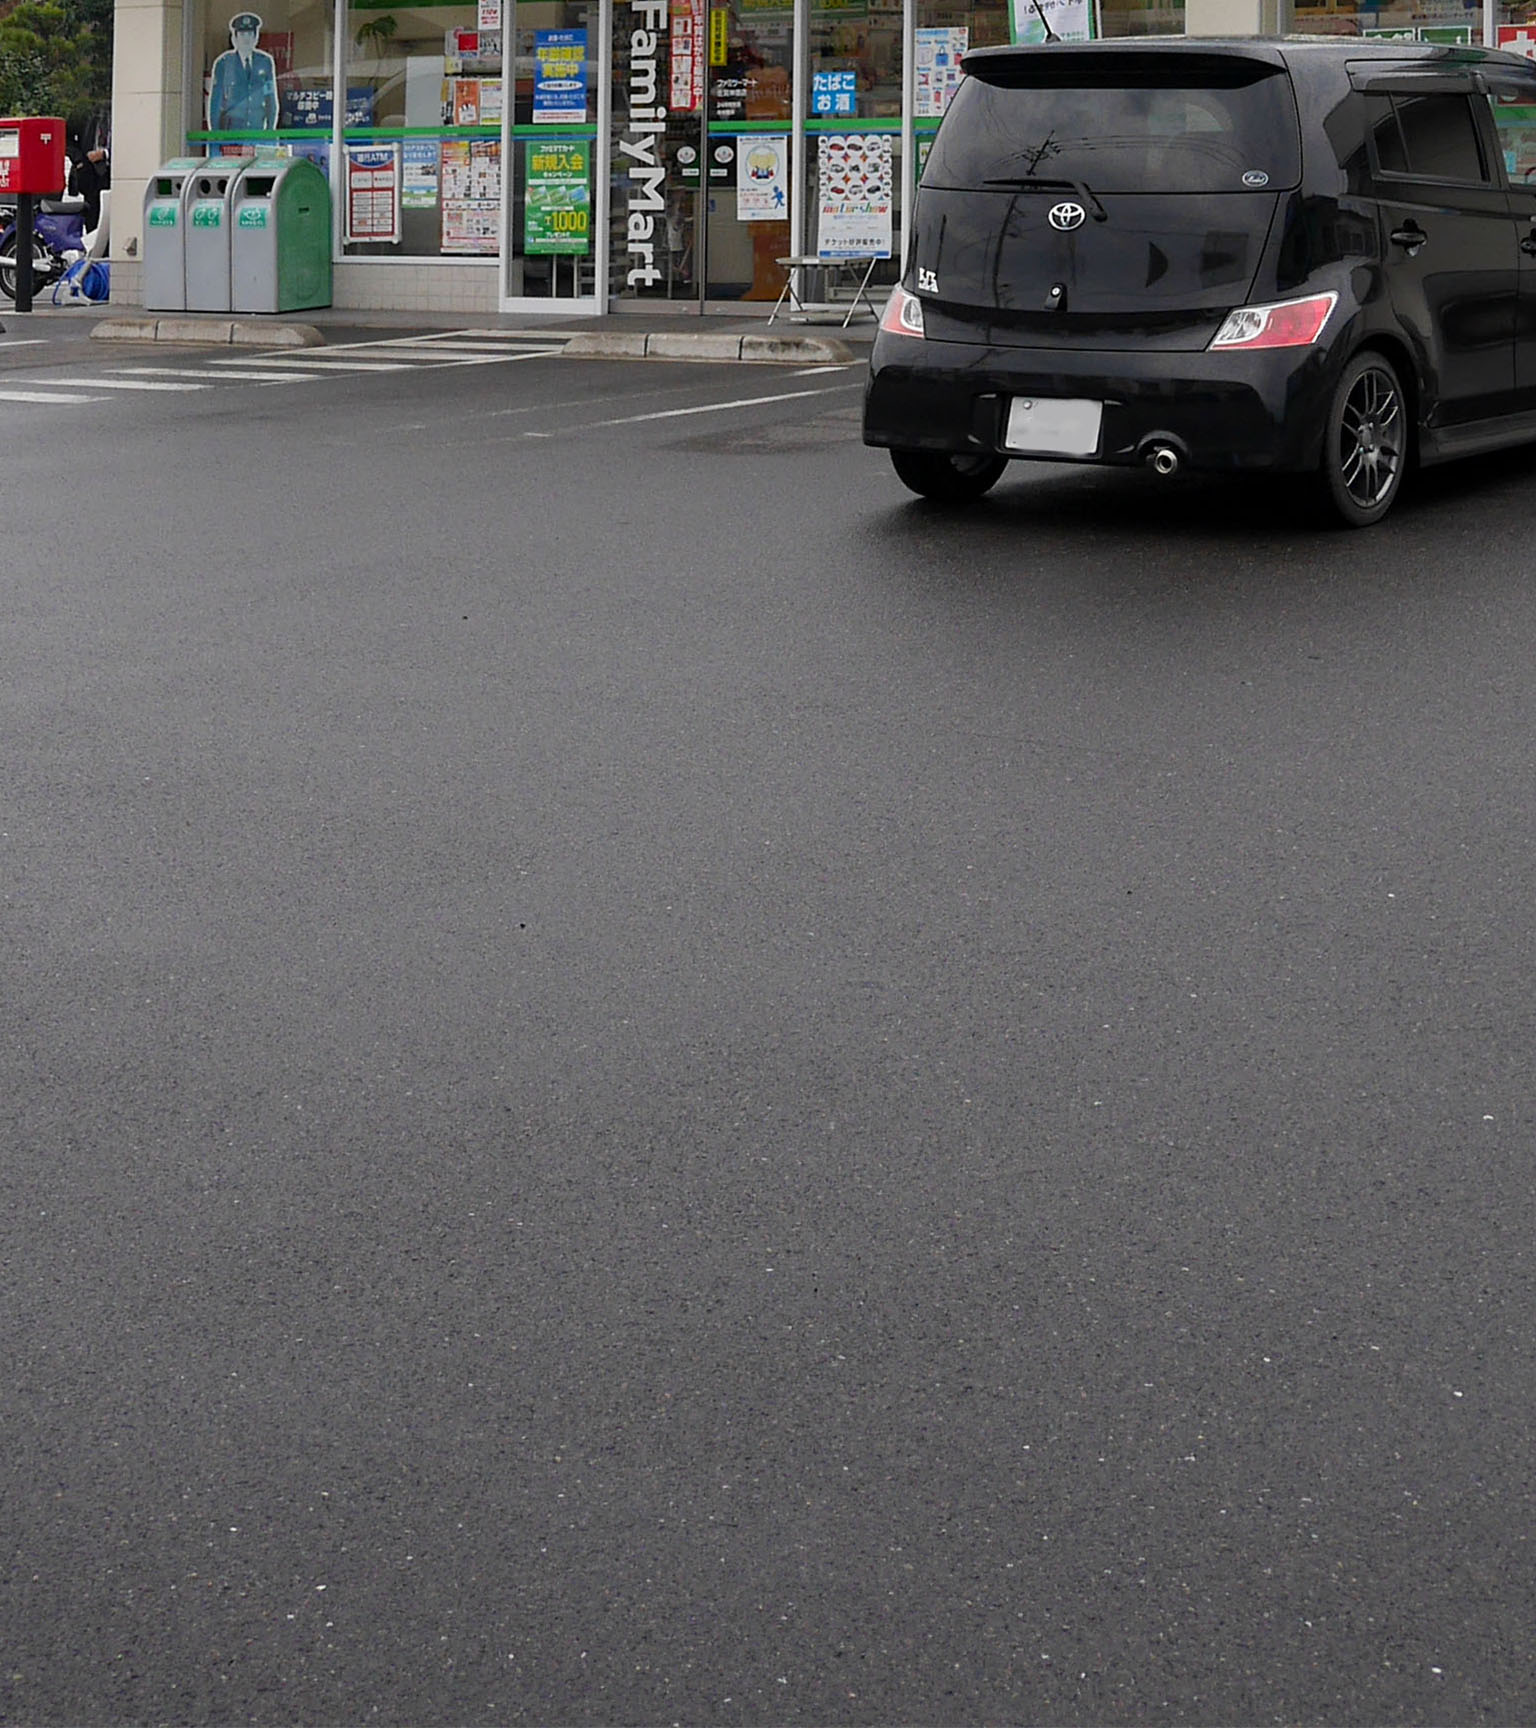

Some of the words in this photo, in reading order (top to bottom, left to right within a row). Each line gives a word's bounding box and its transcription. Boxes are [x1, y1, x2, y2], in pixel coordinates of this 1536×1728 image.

[814, 73, 856, 92] たばこ
[816, 93, 851, 111] お酒
[620, 0, 668, 287] FamilyMart
[531, 153, 584, 172] 新規入会
